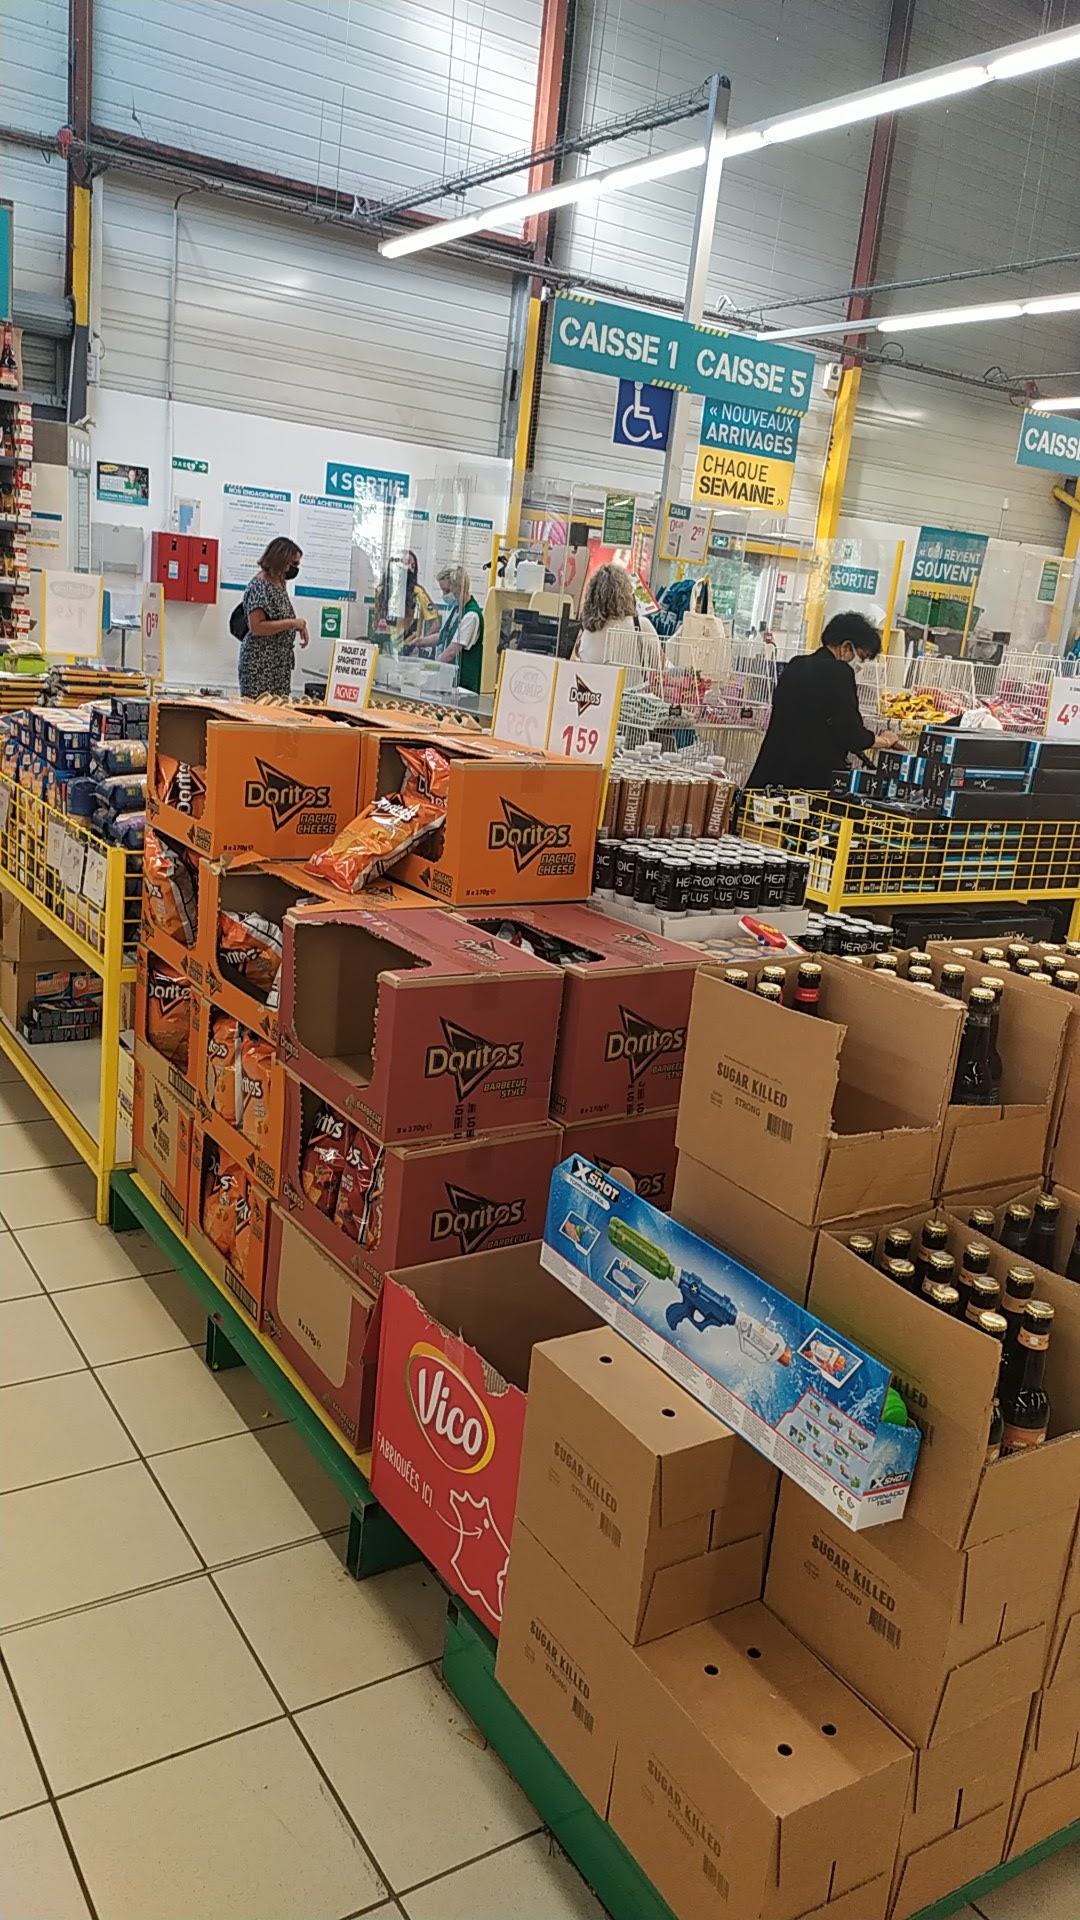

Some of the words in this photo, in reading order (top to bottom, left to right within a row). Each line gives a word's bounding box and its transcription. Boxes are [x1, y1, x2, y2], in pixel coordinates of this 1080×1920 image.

[559, 316, 661, 366] CAISSE
[667, 341, 679, 370] 1
[696, 349, 786, 393] CAISSE
[789, 371, 808, 398] 5
[722, 403, 795, 434] NOUVEAUX
[705, 421, 793, 456] ARRIVAGES
[702, 454, 769, 483] CHAQUE
[243, 489, 287, 501] ENGAGEMENTS
[698, 476, 776, 505] SEMAINE
[944, 549, 981, 564] REVIENT
[834, 570, 876, 590] SORTIE
[915, 560, 979, 583] SOUVENT
[341, 645, 359, 656] PAQUET
[359, 648, 367, 656] DE
[335, 665, 351, 675] PENNE
[569, 687, 602, 706] Doritos
[245, 780, 331, 807] Doritos
[296, 823, 336, 834] CHEESE
[299, 813, 336, 824] NACHO
[489, 821, 572, 849] Doritos
[537, 864, 575, 875] CHEESE
[540, 853, 576, 864] NACHO
[432, 880, 452, 897] CHEESE
[605, 1028, 686, 1061] Doritos
[426, 1043, 523, 1077] Doritos
[483, 1078, 527, 1092] BARBECUE
[500, 1088, 526, 1098] STYLE
[717, 1062, 749, 1090] SUGAR
[751, 1079, 788, 1108] KILLED
[356, 1101, 382, 1121] BARBECUE
[735, 1096, 761, 1117] STRONG
[366, 1116, 381, 1133] STYLE
[431, 1200, 526, 1240] Doritos
[487, 1233, 530, 1249] BARBECUE
[418, 1368, 483, 1456] Vico
[376, 1430, 421, 1494] FABRIQUÉES
[421, 1480, 433, 1508] ICI
[554, 1442, 584, 1481] SUGAR
[586, 1473, 617, 1513] KILLED
[867, 1490, 905, 1503] TORNADO
[811, 1534, 850, 1576] SUGAR
[852, 1569, 895, 1612] KILLED
[835, 1580, 862, 1606] BLOND
[529, 1620, 558, 1661] SUGAR
[559, 1655, 590, 1699] KILLED
[647, 1759, 681, 1810] SUGAR
[685, 1804, 721, 1857] KILLED
